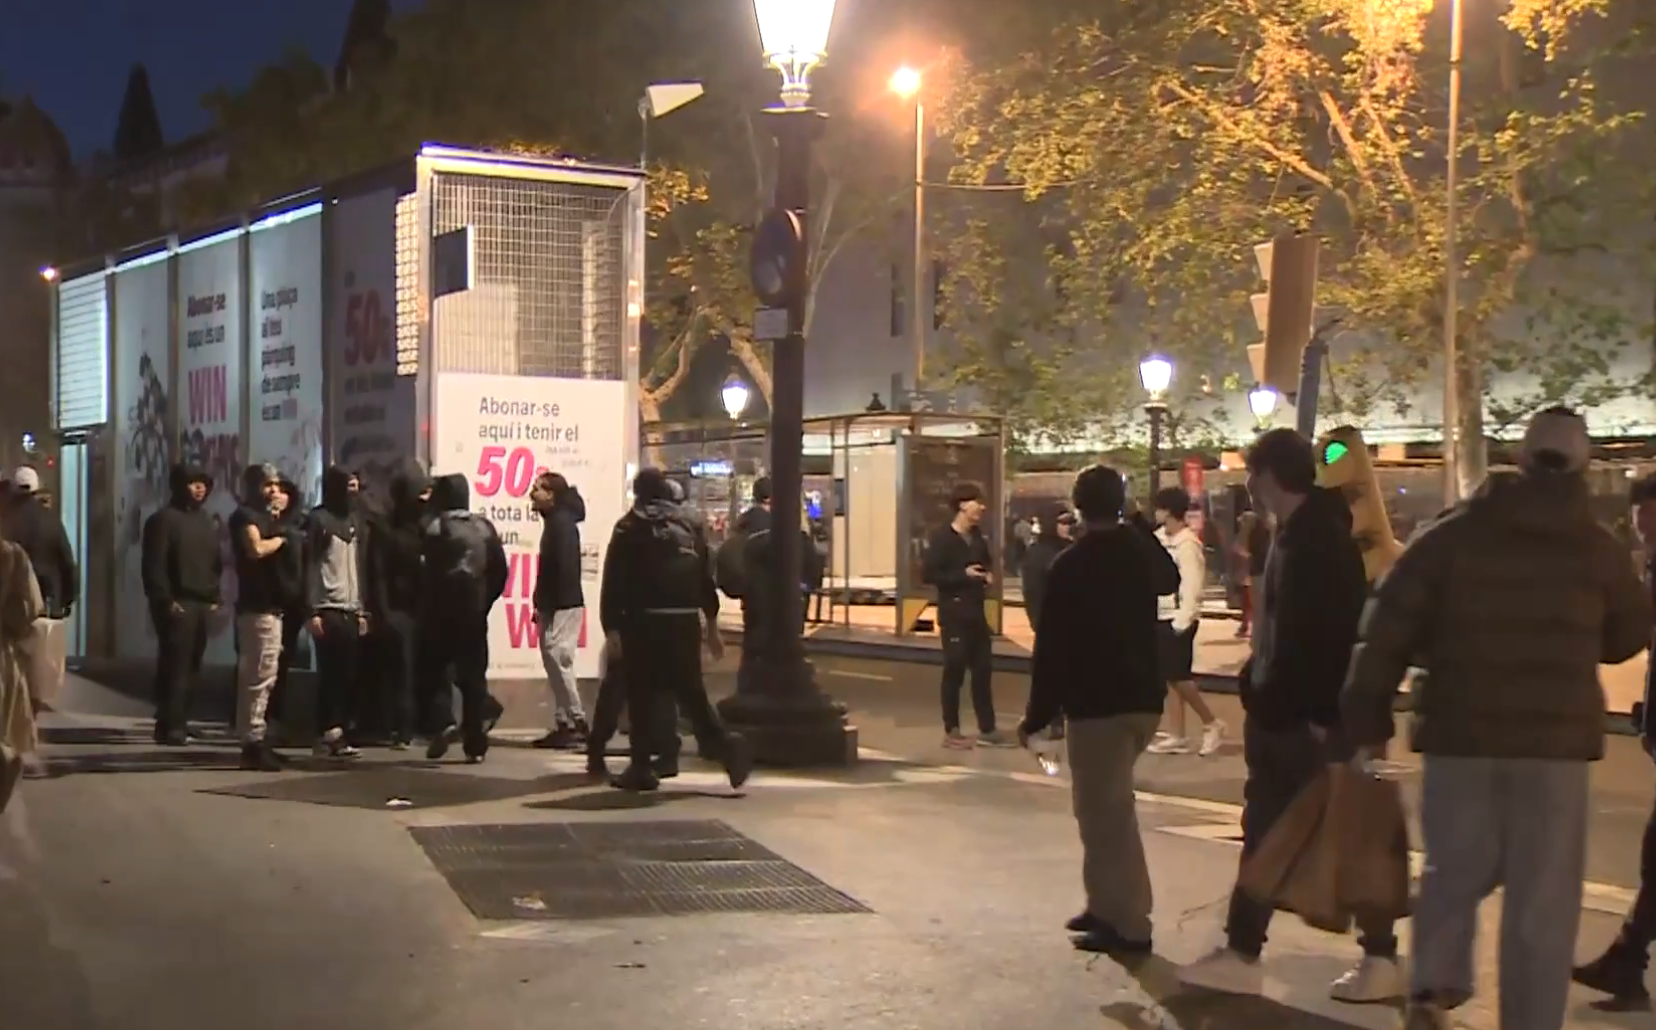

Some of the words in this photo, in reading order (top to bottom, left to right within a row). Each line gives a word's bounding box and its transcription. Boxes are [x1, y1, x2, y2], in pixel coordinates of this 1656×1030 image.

[188, 363, 227, 426] WIN
[479, 397, 560, 417] Abonar-se
[479, 422, 513, 442] aquí
[517, 422, 521, 439] i
[525, 422, 562, 441] tenir
[565, 424, 579, 442] el
[490, 506, 522, 522] tota
[526, 506, 540, 522] la
